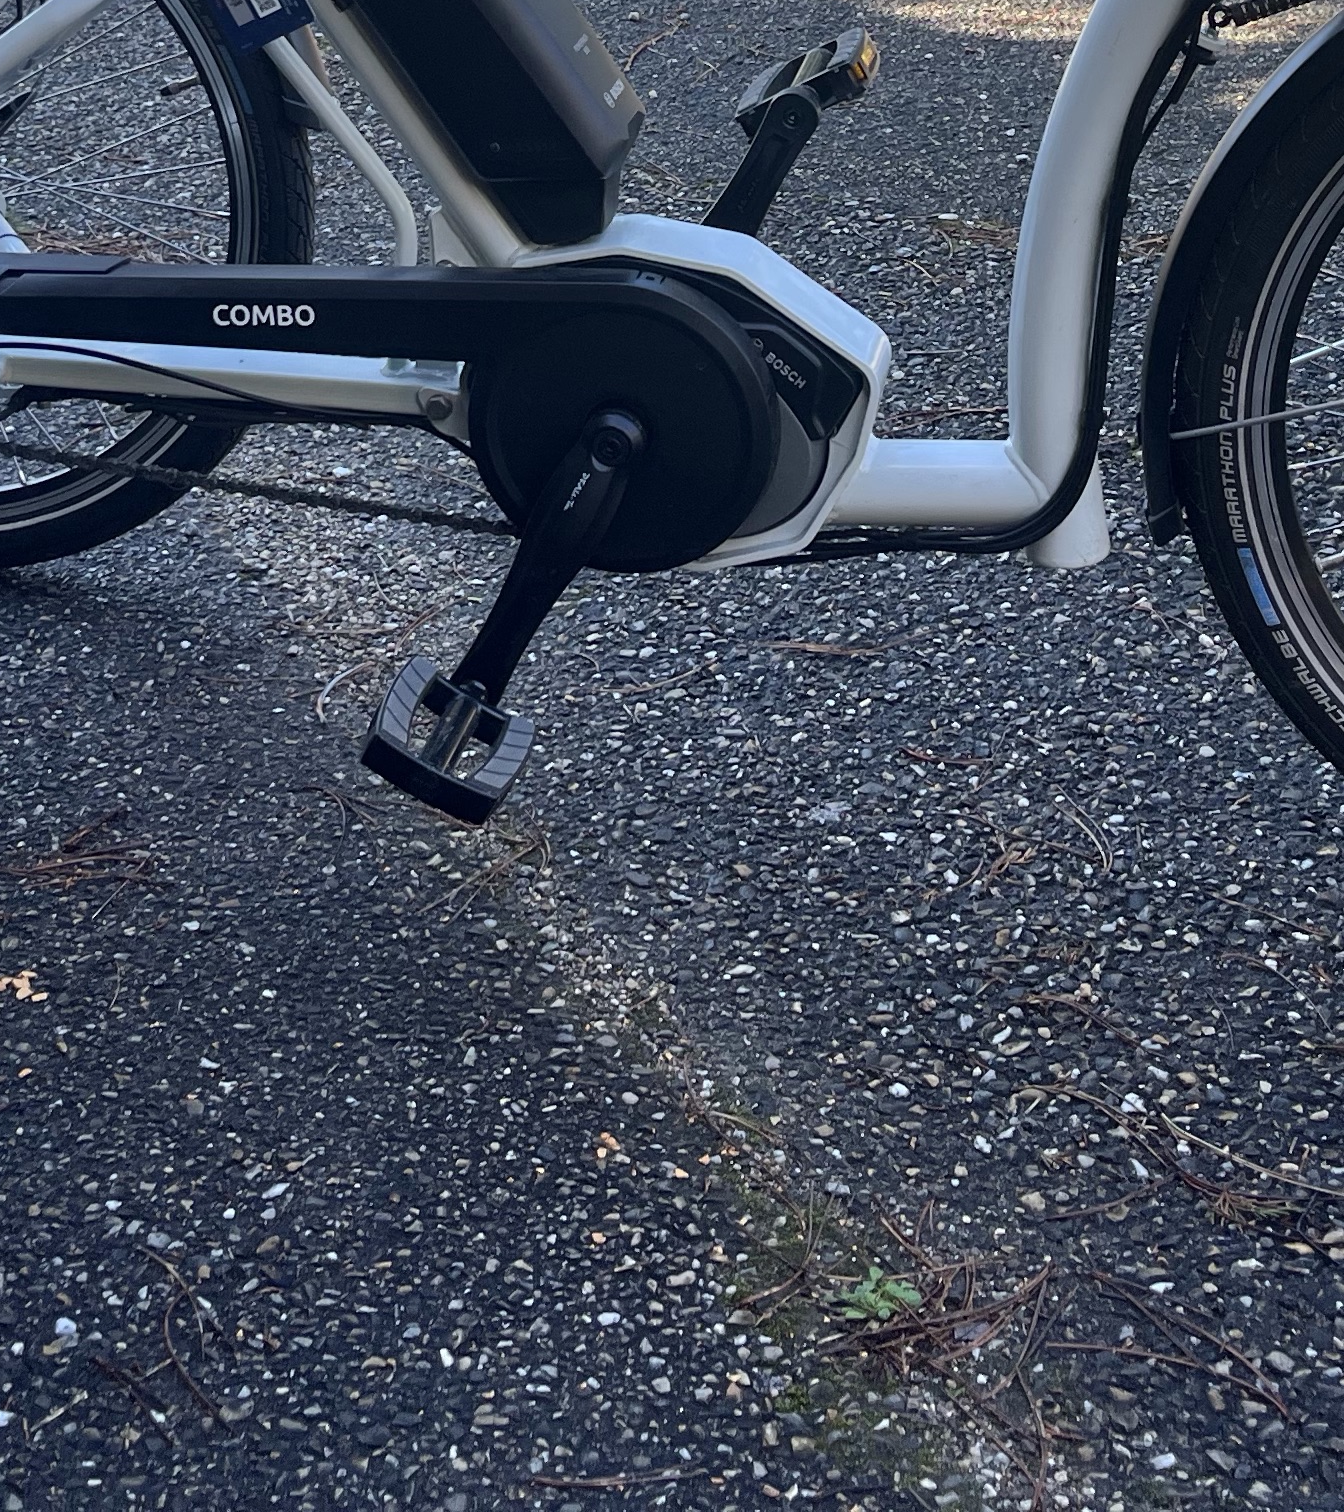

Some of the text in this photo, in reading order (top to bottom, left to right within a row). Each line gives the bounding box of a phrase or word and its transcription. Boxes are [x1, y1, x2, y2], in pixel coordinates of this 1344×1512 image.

[212, 304, 316, 327] COMBO
[765, 351, 807, 389] BOSCH
[1219, 364, 1238, 422] PLUS
